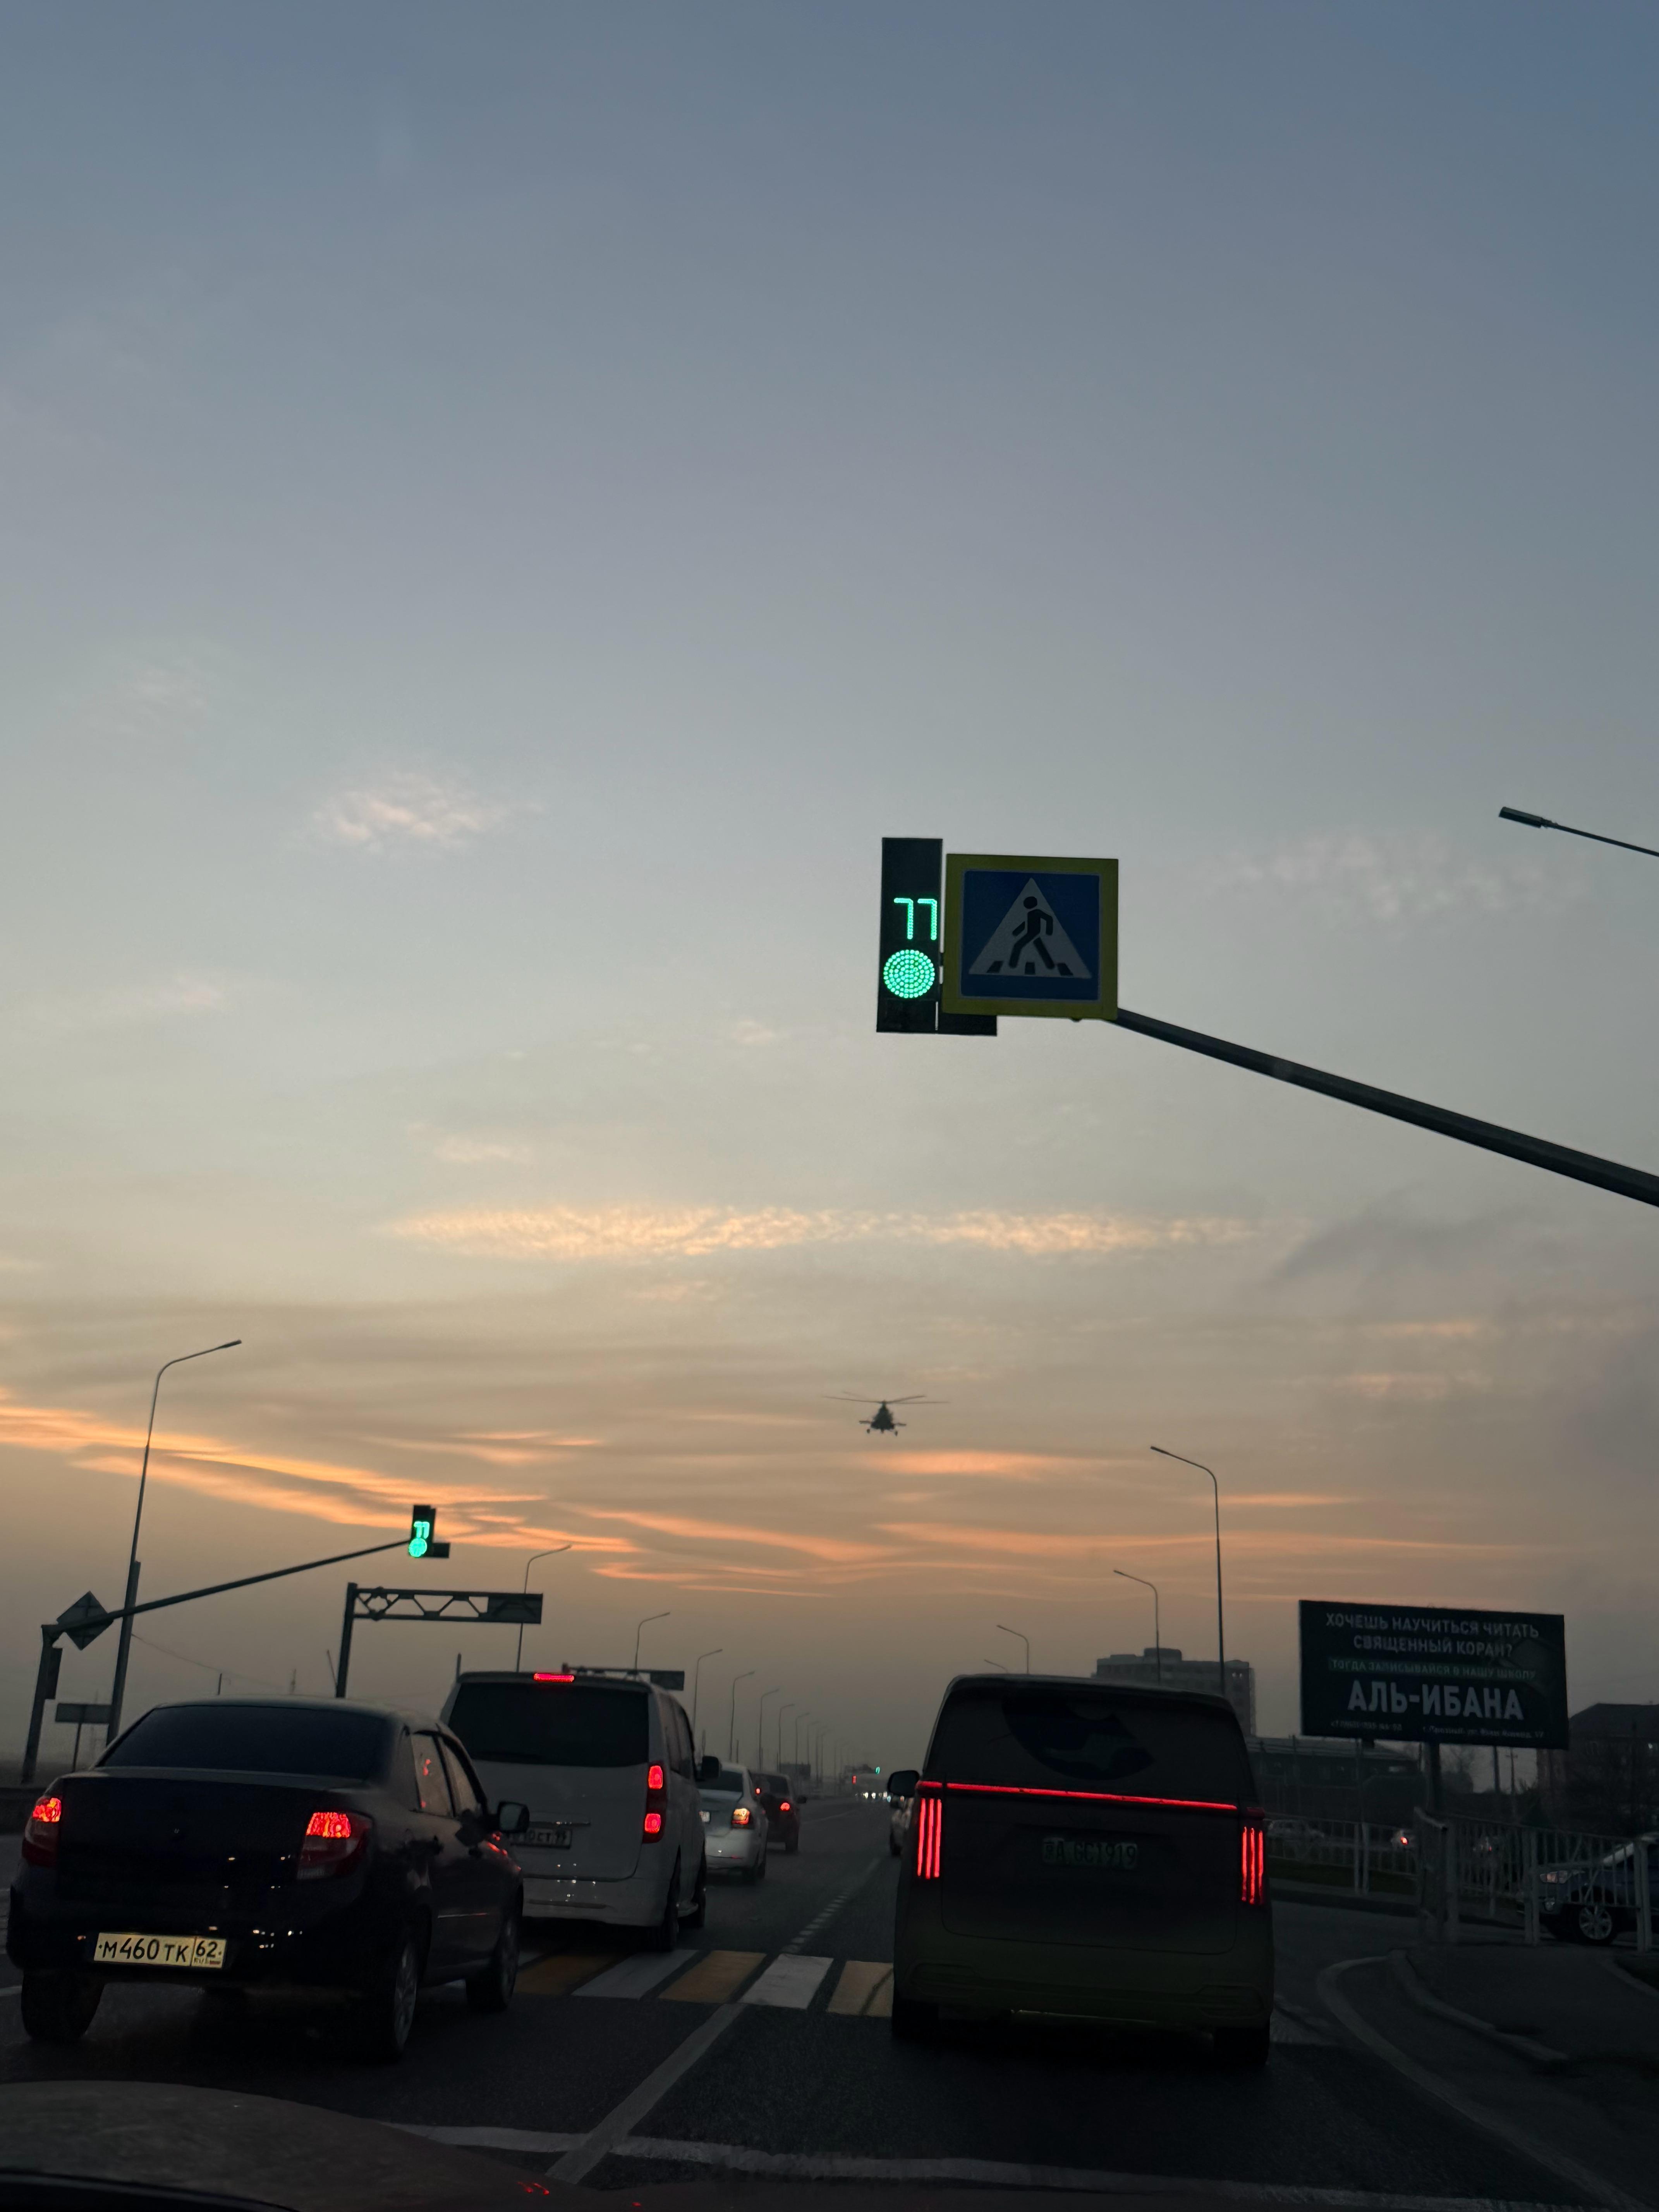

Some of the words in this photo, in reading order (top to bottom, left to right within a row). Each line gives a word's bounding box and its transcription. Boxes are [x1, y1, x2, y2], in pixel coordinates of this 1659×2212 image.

[894, 898, 937, 940] 77
[1326, 1613, 1388, 1630] ХОЧЕШЬ
[1392, 1617, 1479, 1635] НАУЧИТЬСЯ
[1483, 1621, 1539, 1638] ЧИТАТЬ
[1353, 1635, 1452, 1654] СВЯЩЕННЫЙ
[1457, 1640, 1512, 1658] КОРАН?
[1332, 1659, 1366, 1671] ТОГДА
[1368, 1661, 1450, 1675] ЗАПИСЫВАЙСЯ
[1462, 1667, 1494, 1678] НАШУ
[1497, 1669, 1536, 1680] ШКОЛУ
[1347, 1680, 1525, 1720] АЛЬ-ИБАНА
[196, 1940, 218, 1958] 62
